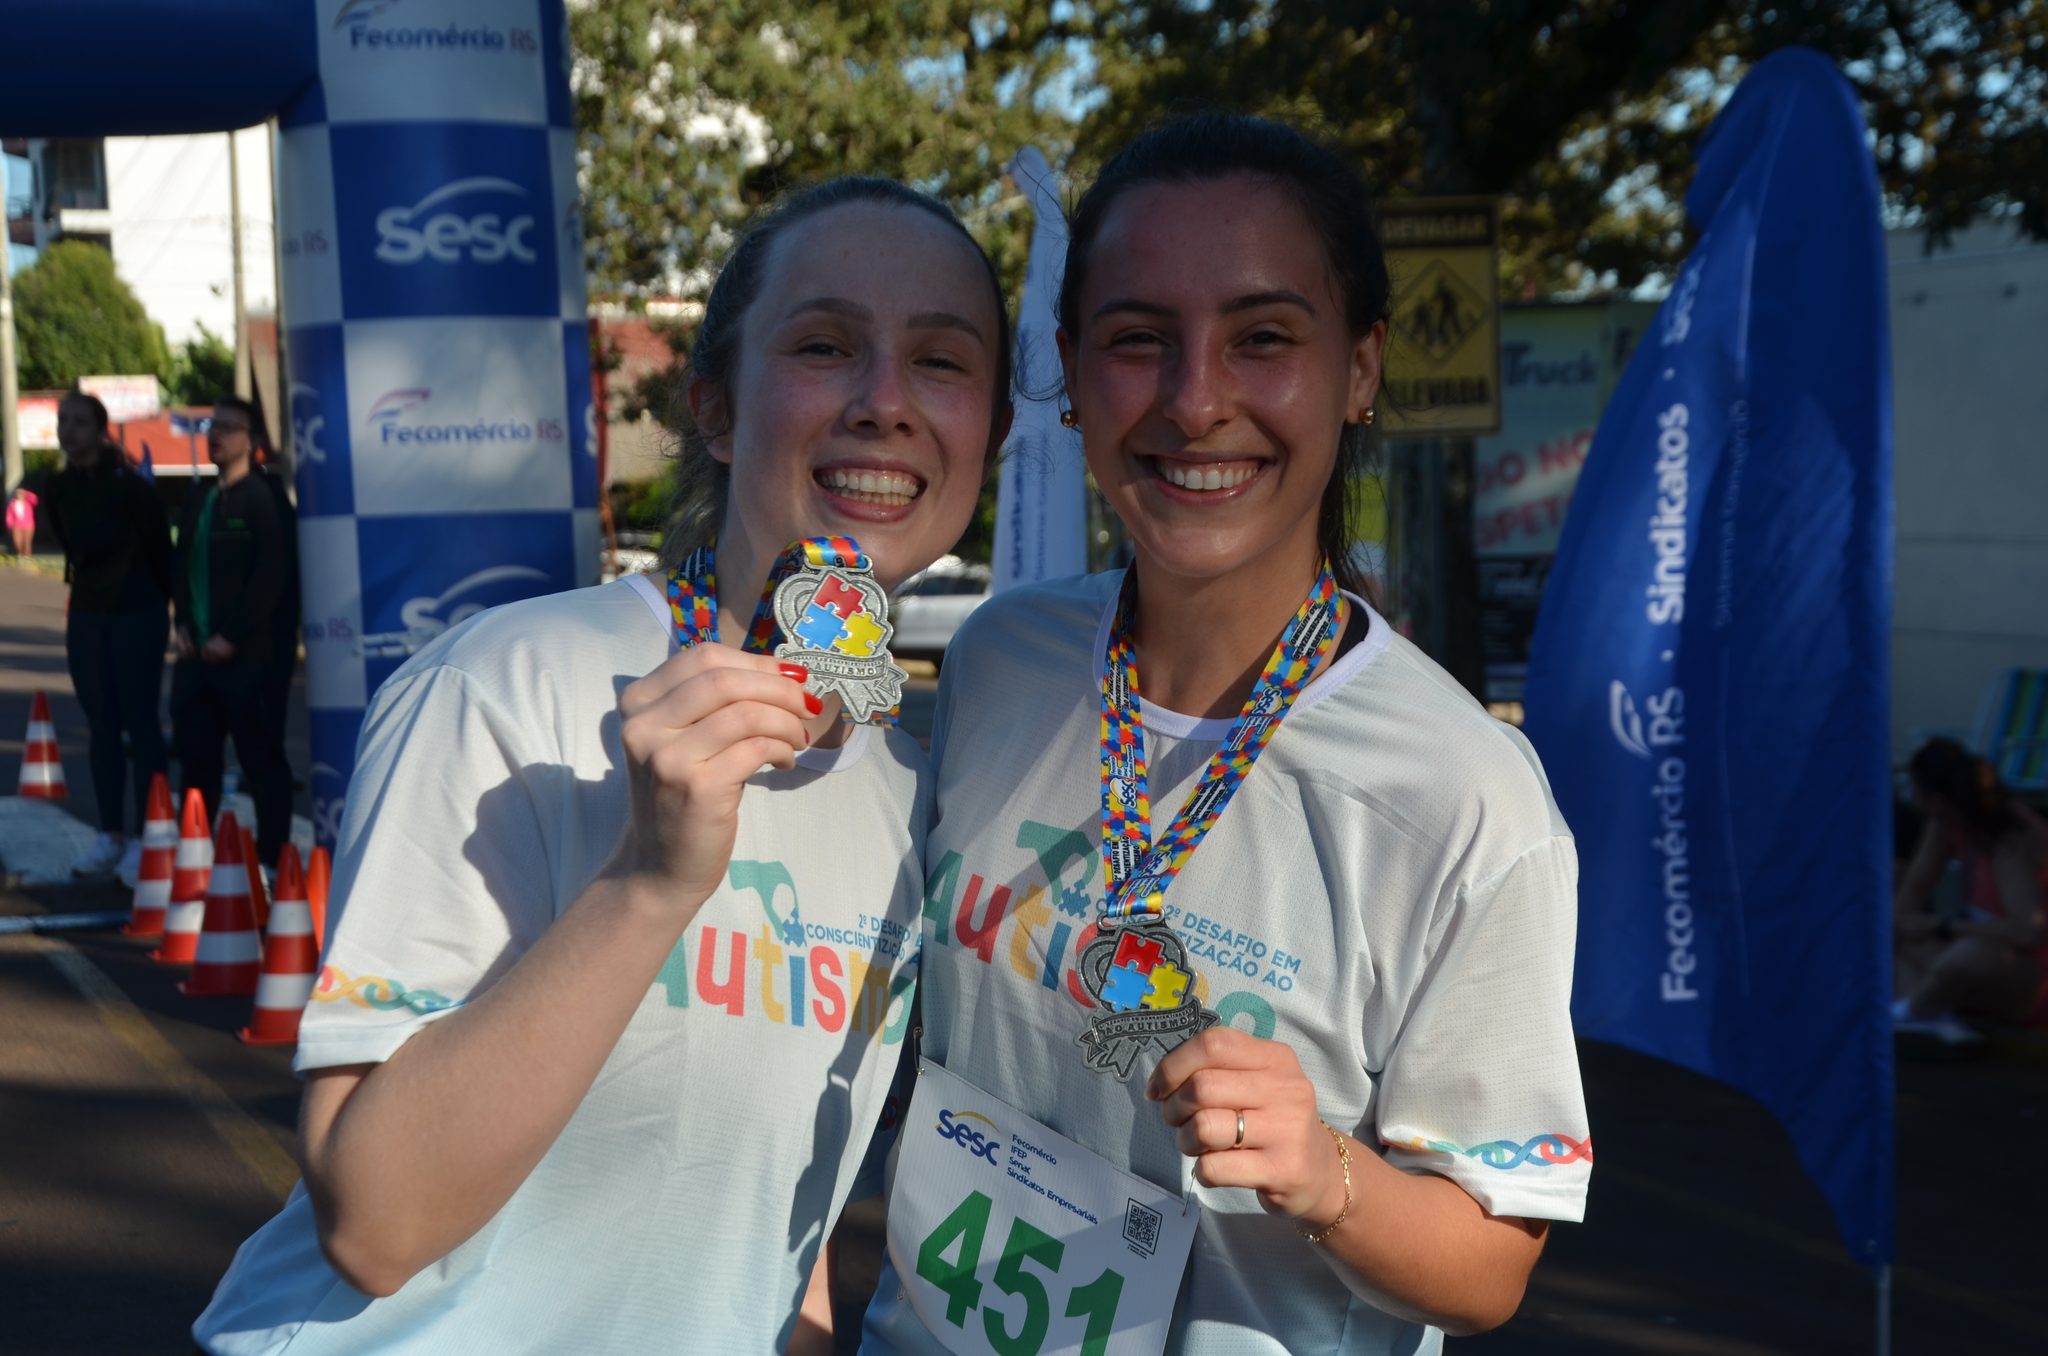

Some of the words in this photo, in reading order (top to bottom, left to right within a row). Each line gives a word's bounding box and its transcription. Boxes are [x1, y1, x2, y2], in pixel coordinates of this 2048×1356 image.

[350, 21, 505, 50] Fecomércio
[509, 27, 538, 57] RS
[375, 205, 537, 265] Sesc
[381, 415, 532, 446] Fecomércio
[537, 418, 565, 443] RS
[1646, 402, 1690, 626] Sindicatos
[814, 662, 876, 676] AUTISMO
[1646, 686, 1685, 747] RS
[1111, 850, 1121, 875] DESAFIO
[1652, 758, 1699, 1002] Fecomércio
[1165, 904, 1182, 921] 2º
[1182, 911, 1268, 959] DESAFIO
[1270, 948, 1302, 975] EM
[1261, 969, 1294, 992] AO
[1105, 1023, 1123, 1036] AO
[1127, 1016, 1189, 1031] AUTISMO
[936, 1108, 1001, 1167] Sesc
[1010, 1145, 1028, 1159] IFEP
[1012, 1134, 1058, 1166] Fecomércio
[1008, 1156, 1032, 1175] Senac
[1006, 1166, 1046, 1196] Sindicatos
[1046, 1189, 1099, 1225] Empresariais
[915, 1189, 1126, 1356] 451
